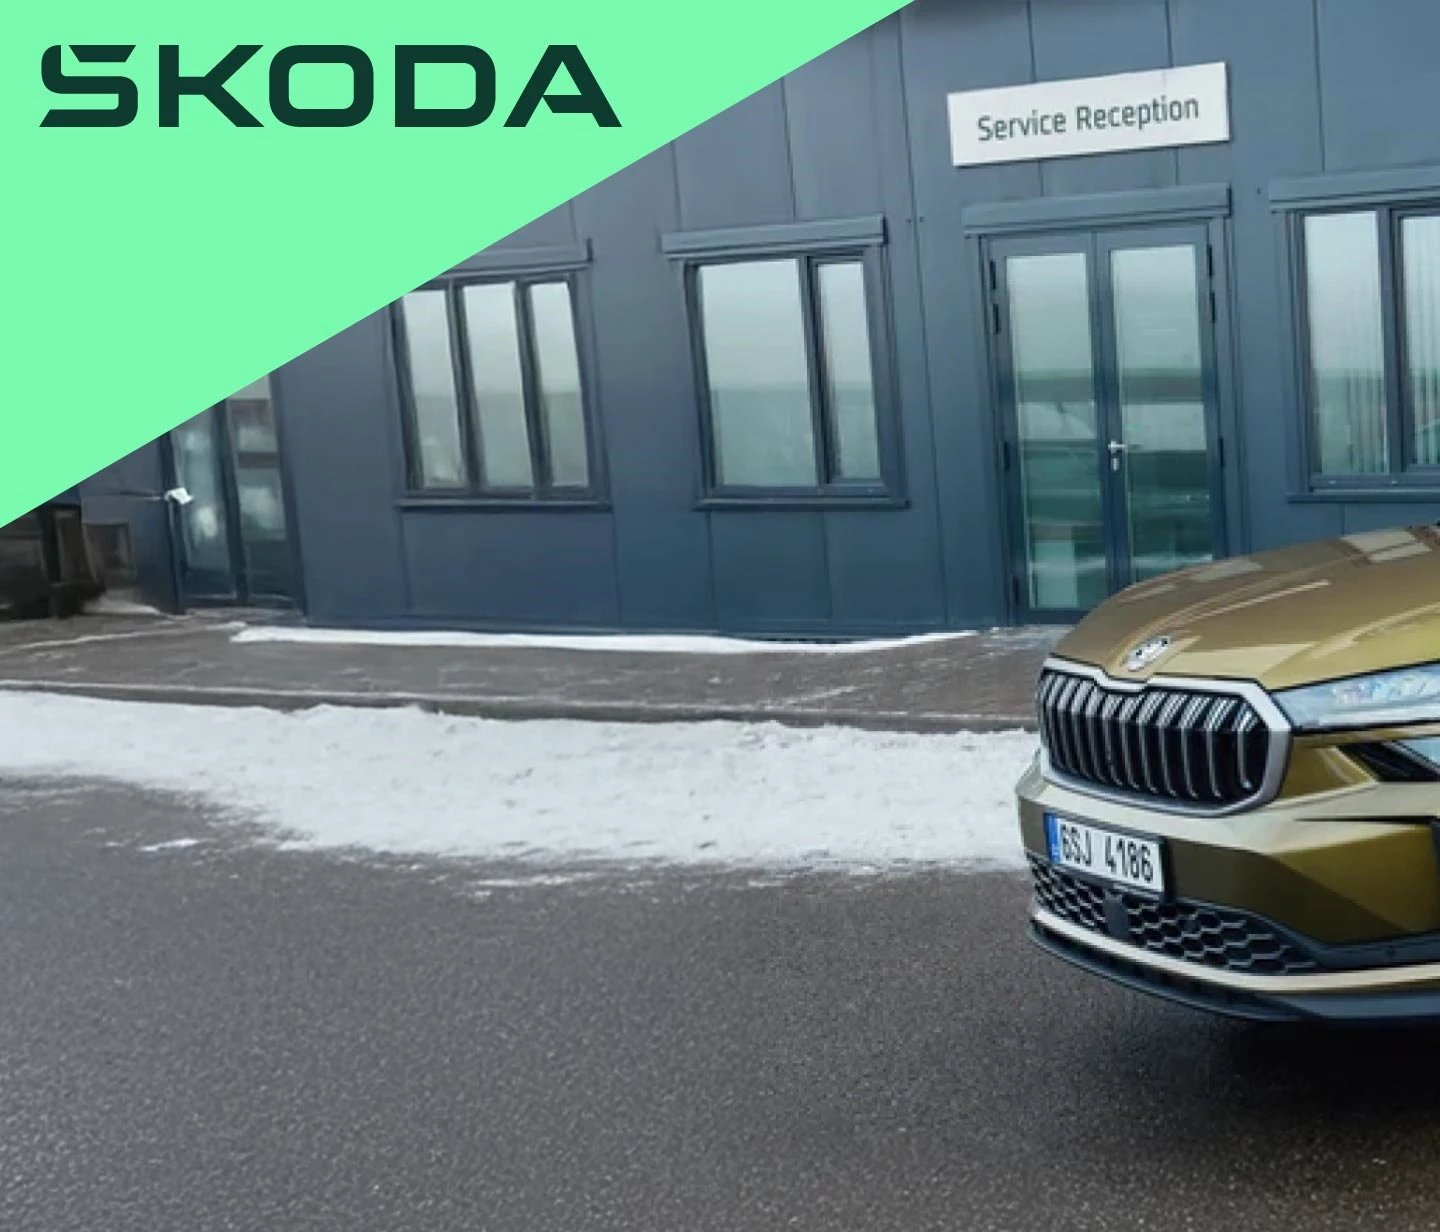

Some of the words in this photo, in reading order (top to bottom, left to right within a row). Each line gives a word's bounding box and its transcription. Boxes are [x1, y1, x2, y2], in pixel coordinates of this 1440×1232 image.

[977, 109, 1067, 141] Service
[1075, 95, 1199, 131] Reception
[1061, 823, 1092, 867] 6SJ
[1104, 835, 1153, 883] 4186
